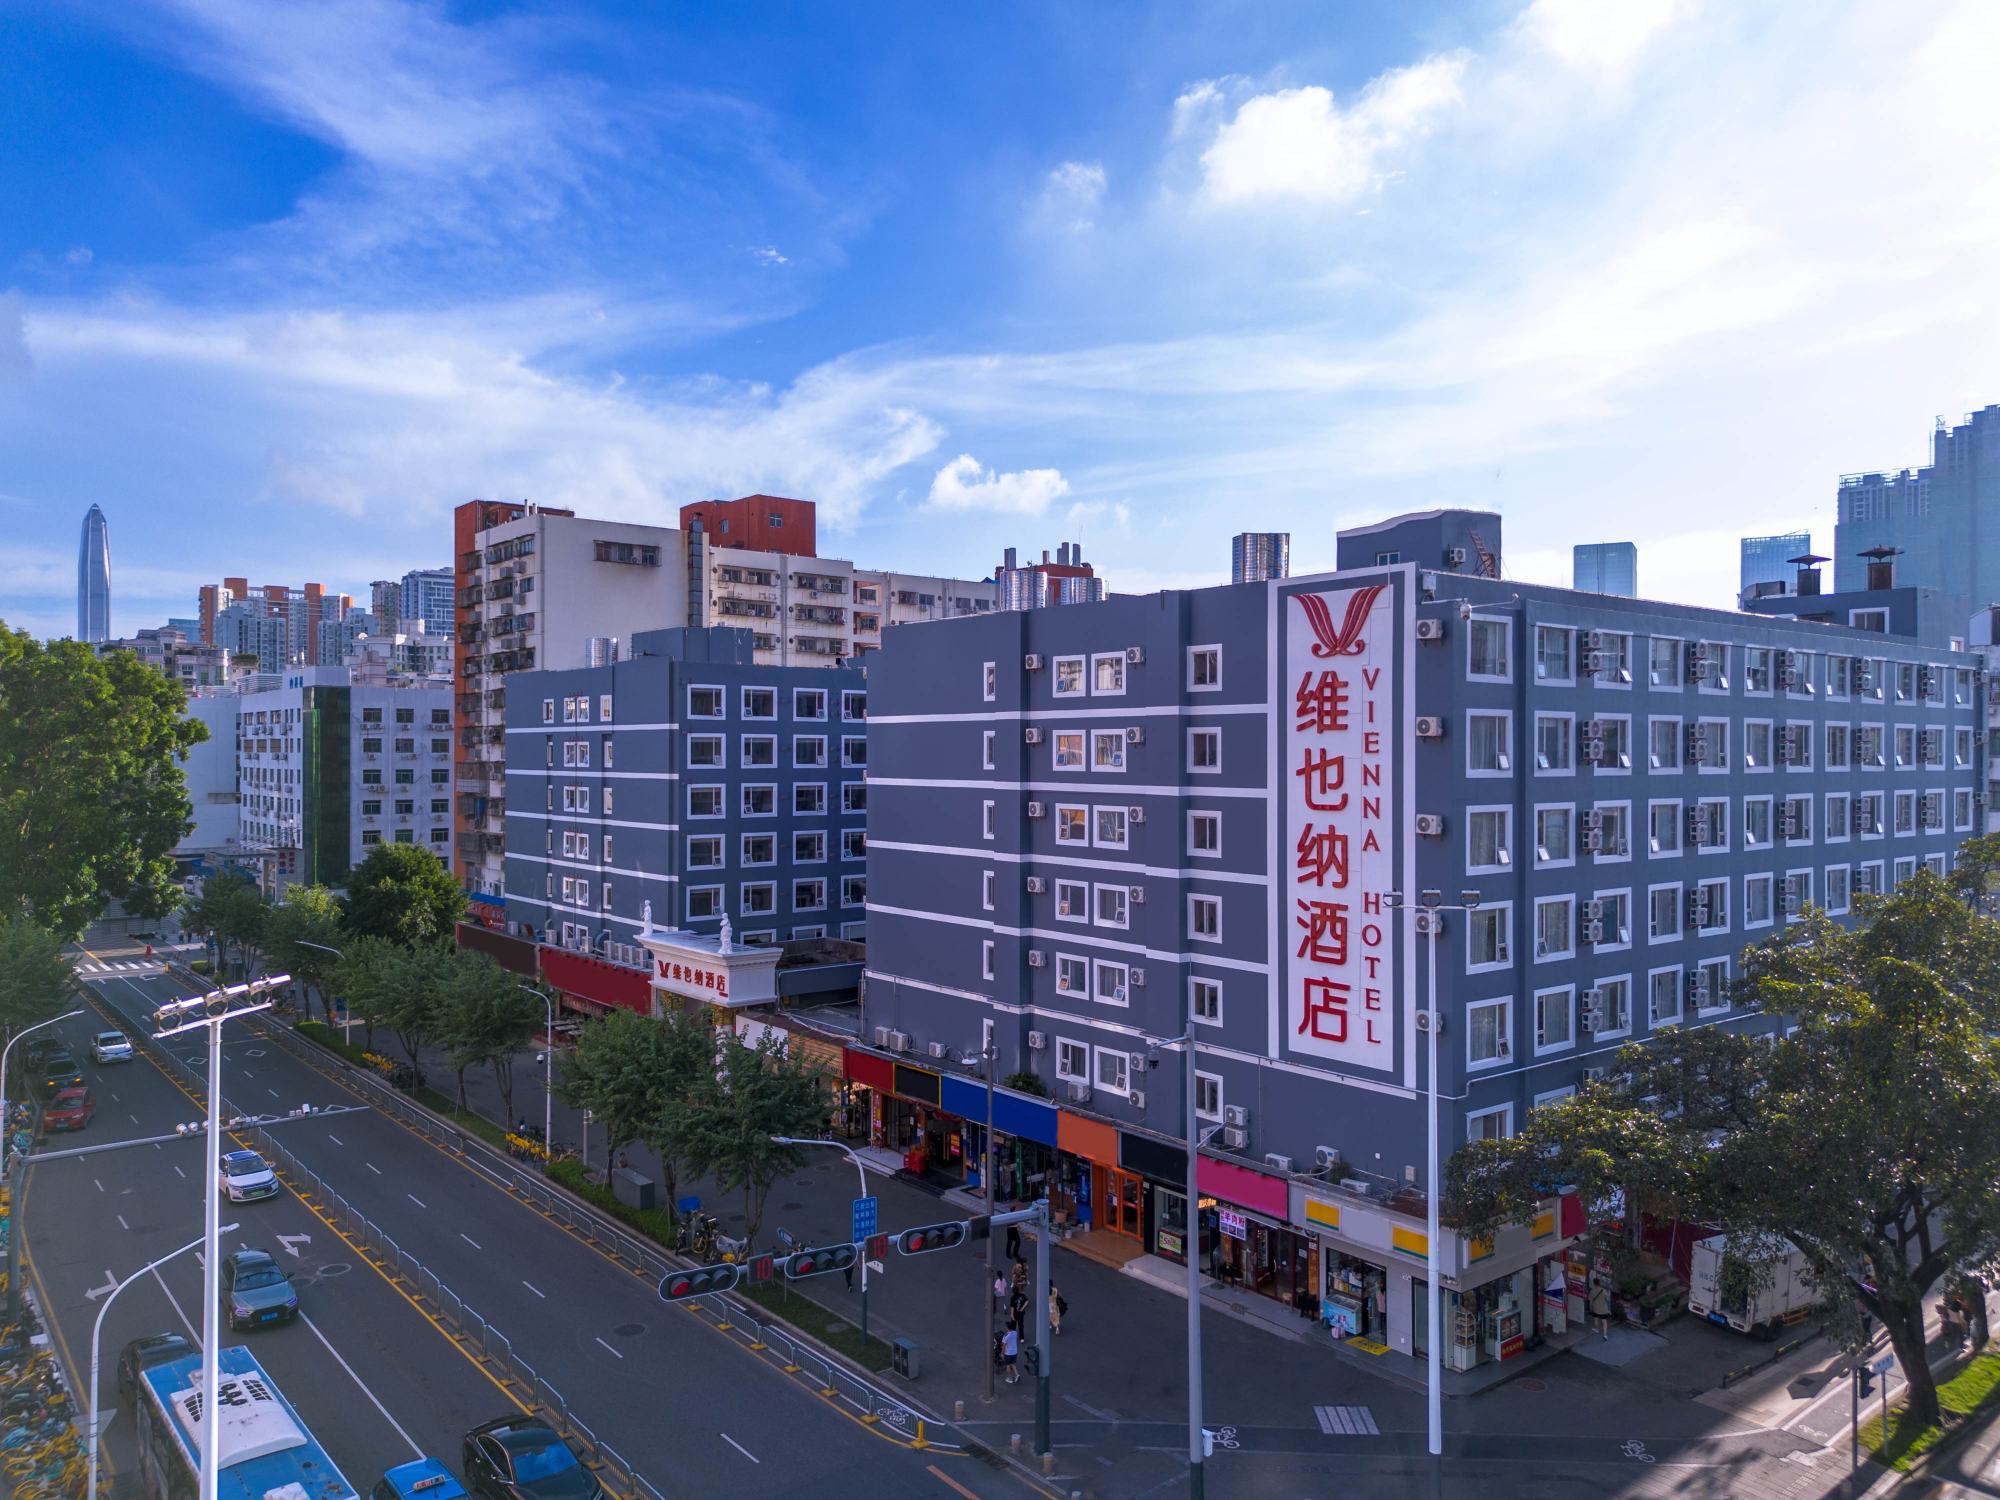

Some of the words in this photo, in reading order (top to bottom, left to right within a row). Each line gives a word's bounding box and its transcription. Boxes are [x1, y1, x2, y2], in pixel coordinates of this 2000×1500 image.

[1362, 667, 1381, 852] VIENNA
[1296, 671, 1351, 1043] 维也纳酒店
[673, 963, 726, 992] 维也纳酒店
[1362, 891, 1382, 1044] HOTEL
[756, 1256, 772, 1281] 10
